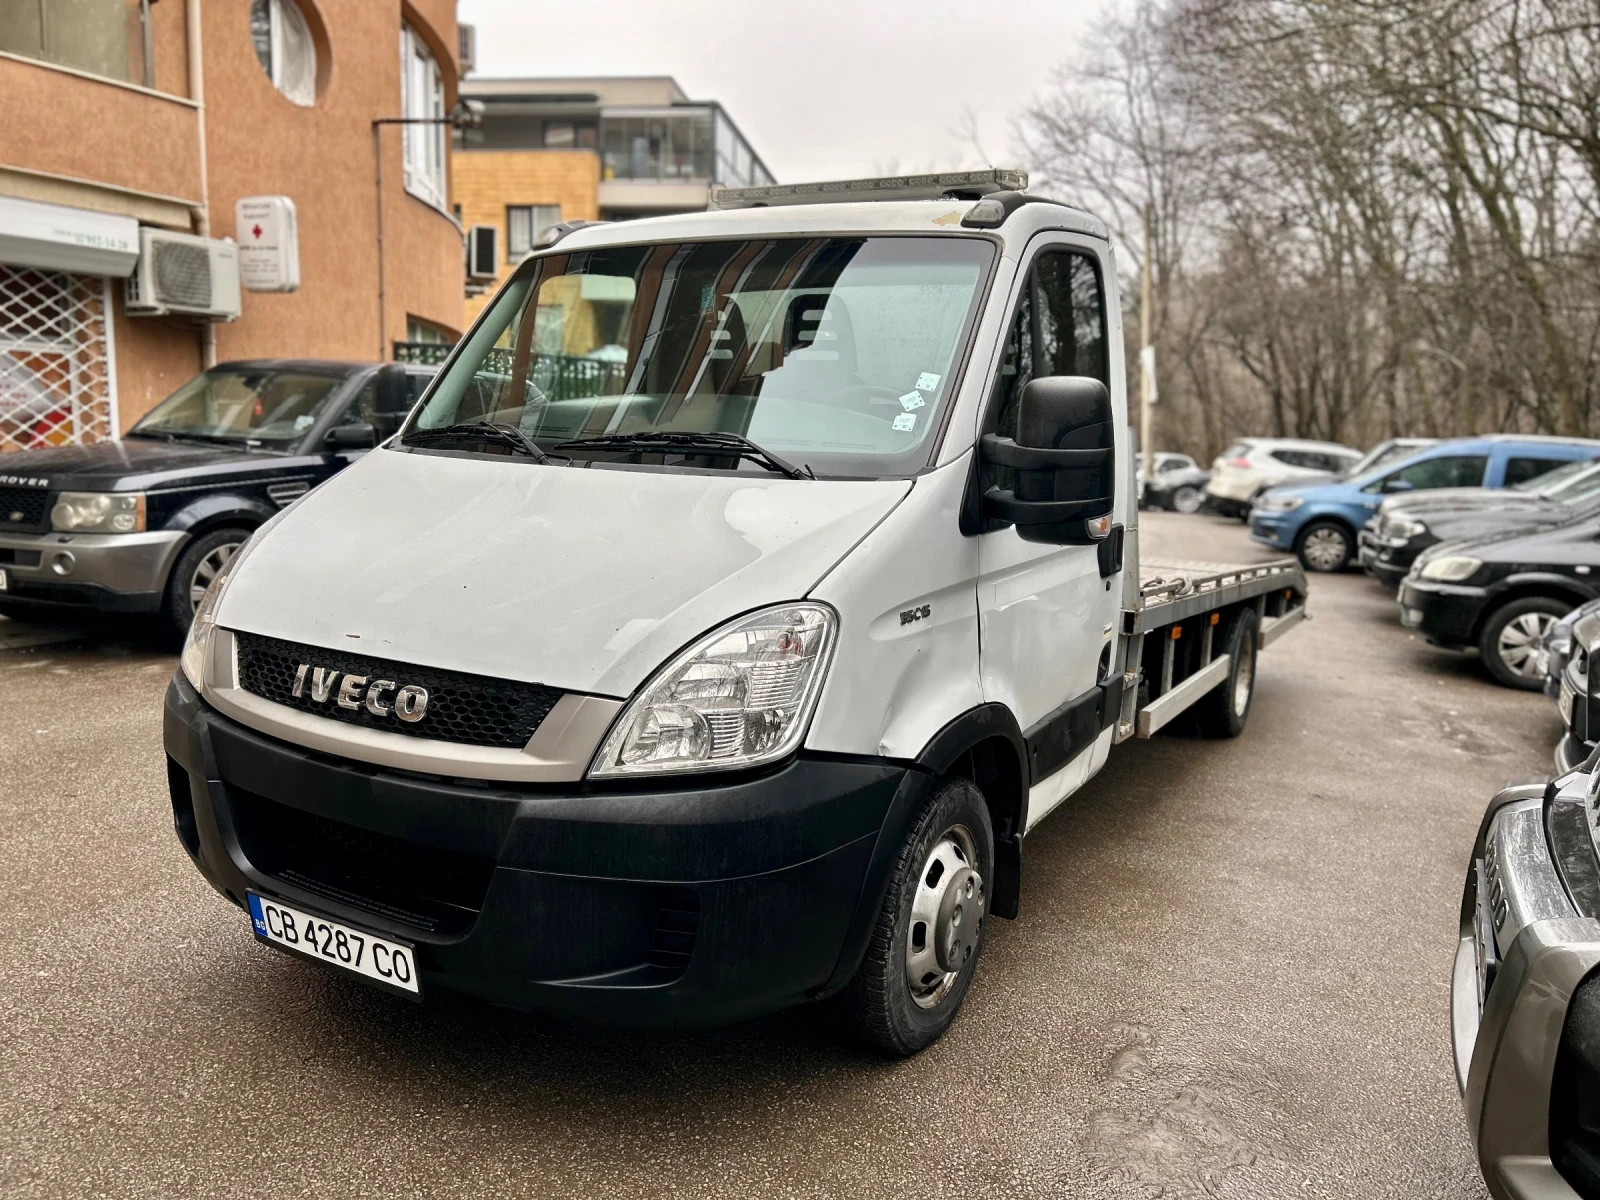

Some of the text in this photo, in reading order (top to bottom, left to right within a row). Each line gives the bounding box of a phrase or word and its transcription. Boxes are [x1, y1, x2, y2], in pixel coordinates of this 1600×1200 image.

[292, 664, 429, 722] IVECO
[265, 905, 299, 944] CB
[304, 919, 365, 967] 4287
